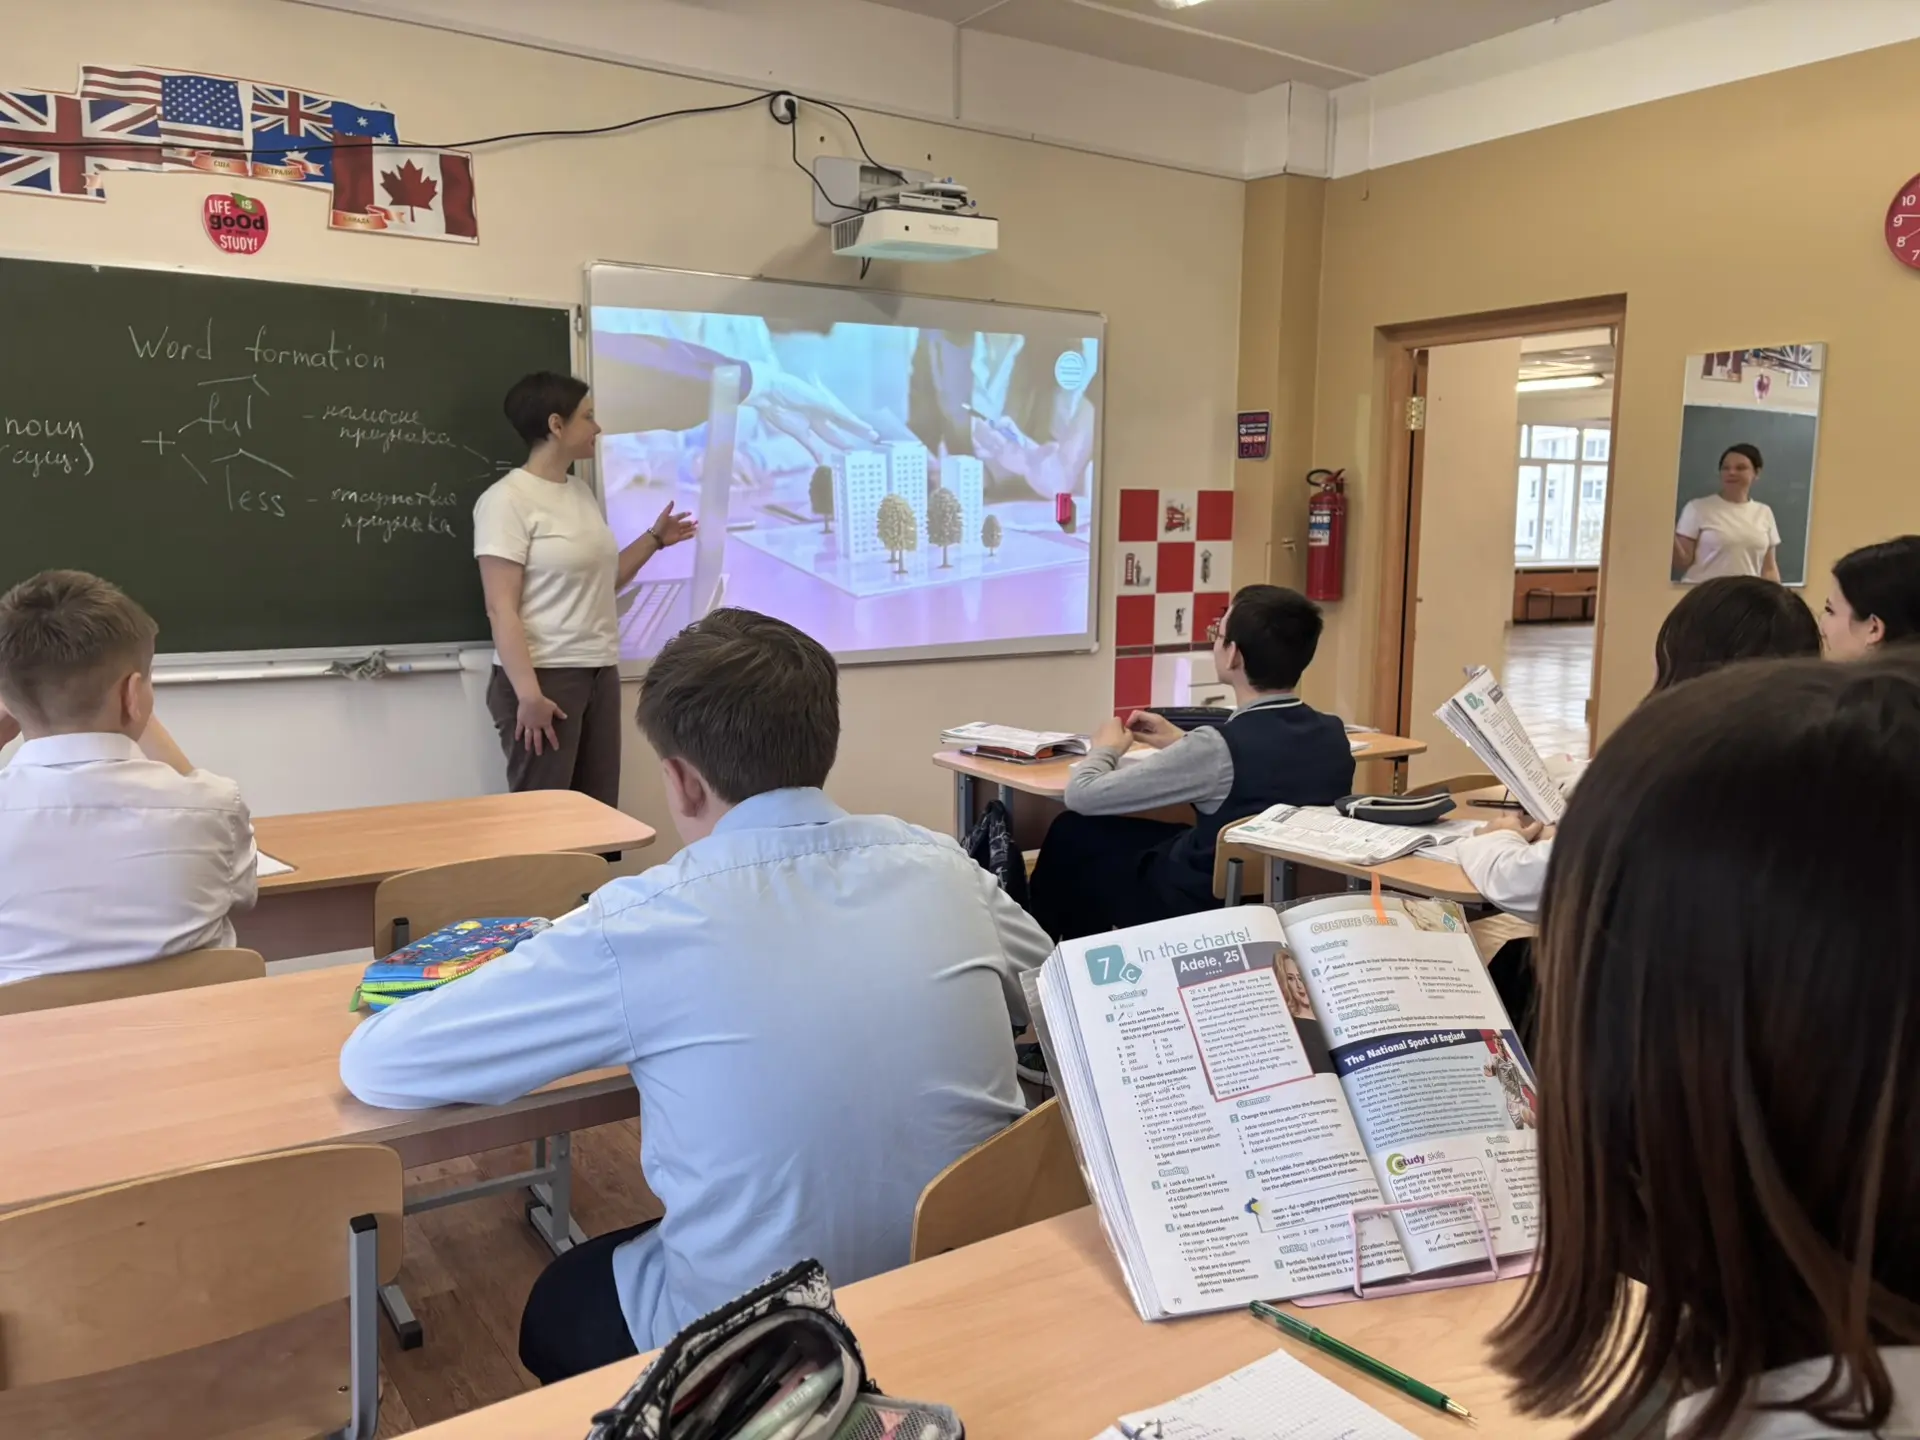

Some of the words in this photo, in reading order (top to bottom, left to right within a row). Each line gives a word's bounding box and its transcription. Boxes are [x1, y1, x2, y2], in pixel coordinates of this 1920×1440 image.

[213, 160, 231, 168] США
[208, 199, 232, 215] LIFE
[241, 200, 253, 210] IS
[1902, 194, 1916, 206] 10
[1893, 214, 1903, 227] 9
[219, 234, 258, 251] STUDY!
[1896, 236, 1906, 248] 8
[1911, 249, 1920, 261] 7
[128, 317, 213, 361] Word
[245, 323, 385, 370] formation
[5, 416, 84, 440] noun
[226, 464, 286, 516] less
[1138, 946, 1155, 963] In
[1159, 941, 1189, 958] the
[1193, 926, 1252, 950] charts!
[1097, 957, 1110, 980] 7
[1180, 955, 1222, 974] Adele,
[1223, 950, 1240, 964] 25
[1344, 1054, 1365, 1066] The
[1366, 1040, 1407, 1059] National
[1408, 1038, 1429, 1049] Sport
[1431, 1034, 1438, 1044] of
[1439, 1030, 1466, 1044] England
[1276, 1151, 1303, 1162] formation
[1397, 1154, 1425, 1167] study
[1427, 1150, 1445, 1161] skills
[1159, 1166, 1189, 1177] Reading
